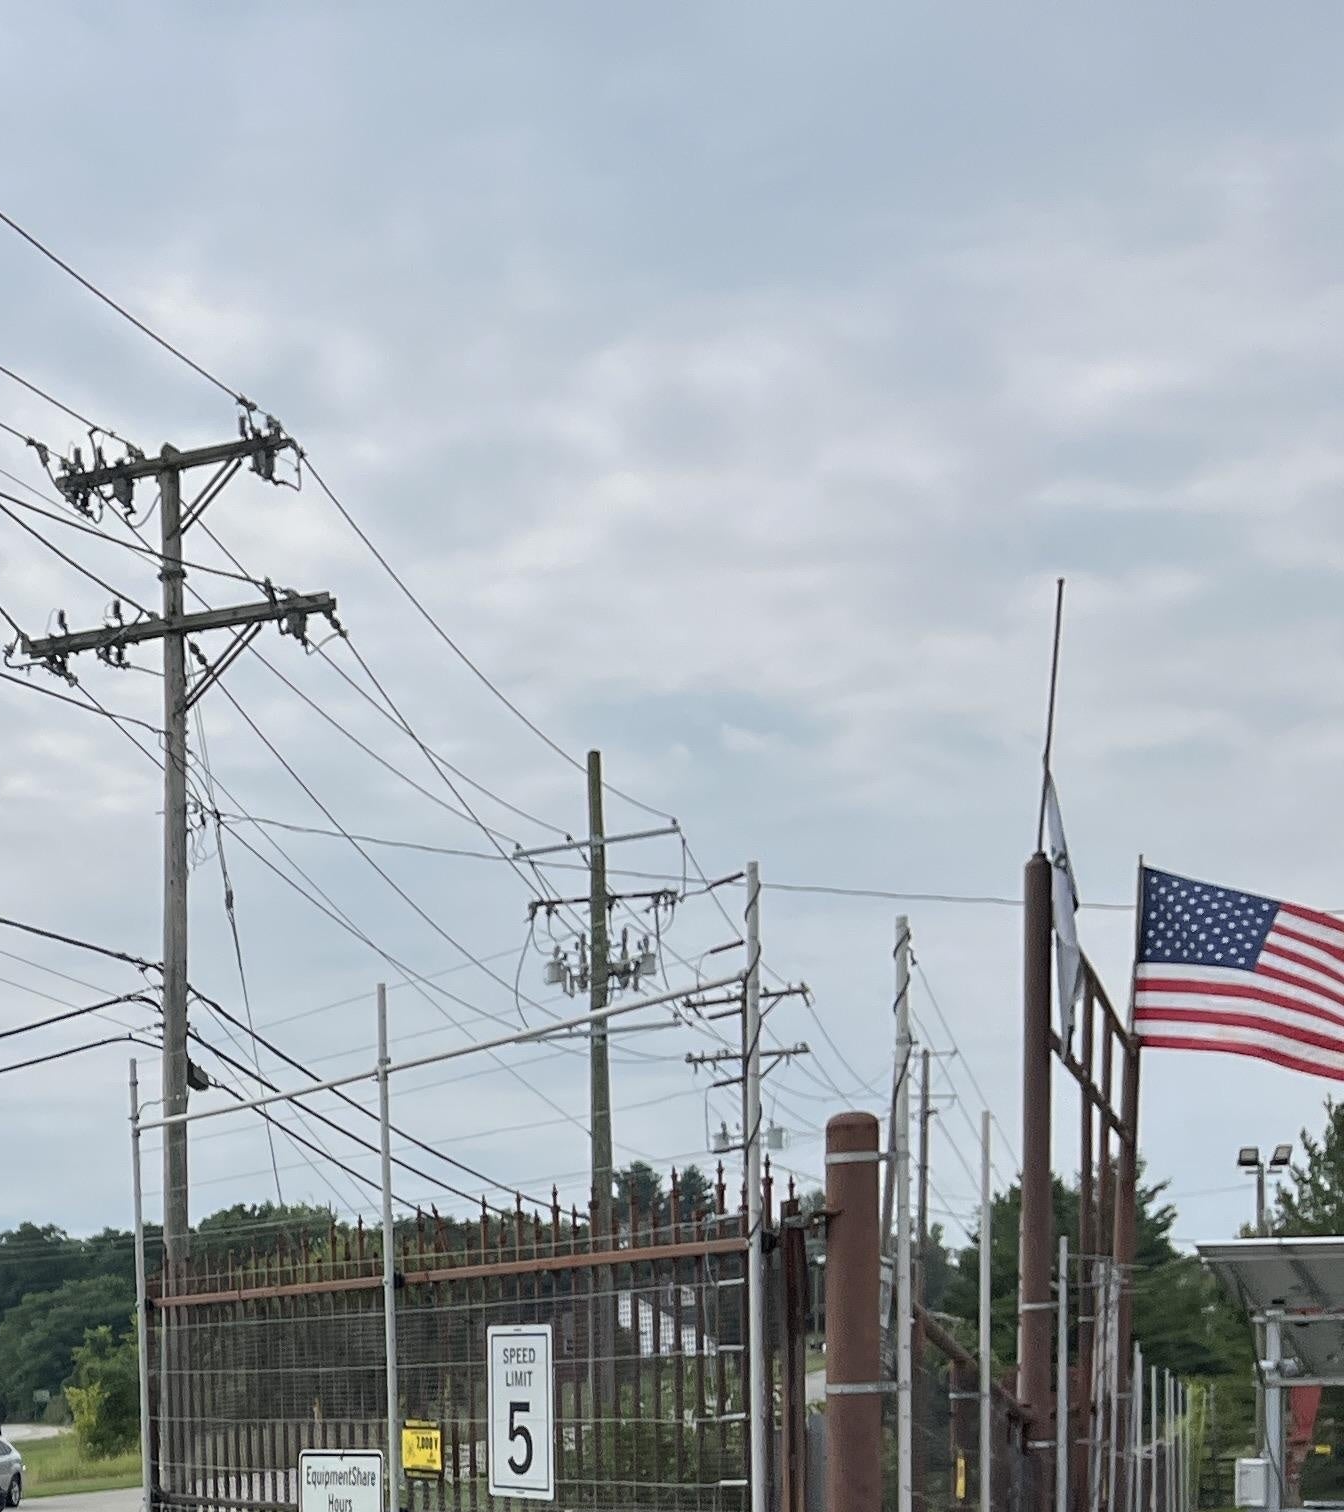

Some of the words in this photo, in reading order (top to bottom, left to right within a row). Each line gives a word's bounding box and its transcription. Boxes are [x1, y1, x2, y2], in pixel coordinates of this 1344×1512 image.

[503, 1347, 536, 1364] SPEED
[505, 1370, 533, 1388] LIMIT
[507, 1401, 534, 1476] 5
[306, 1465, 377, 1489] EquipmentShare
